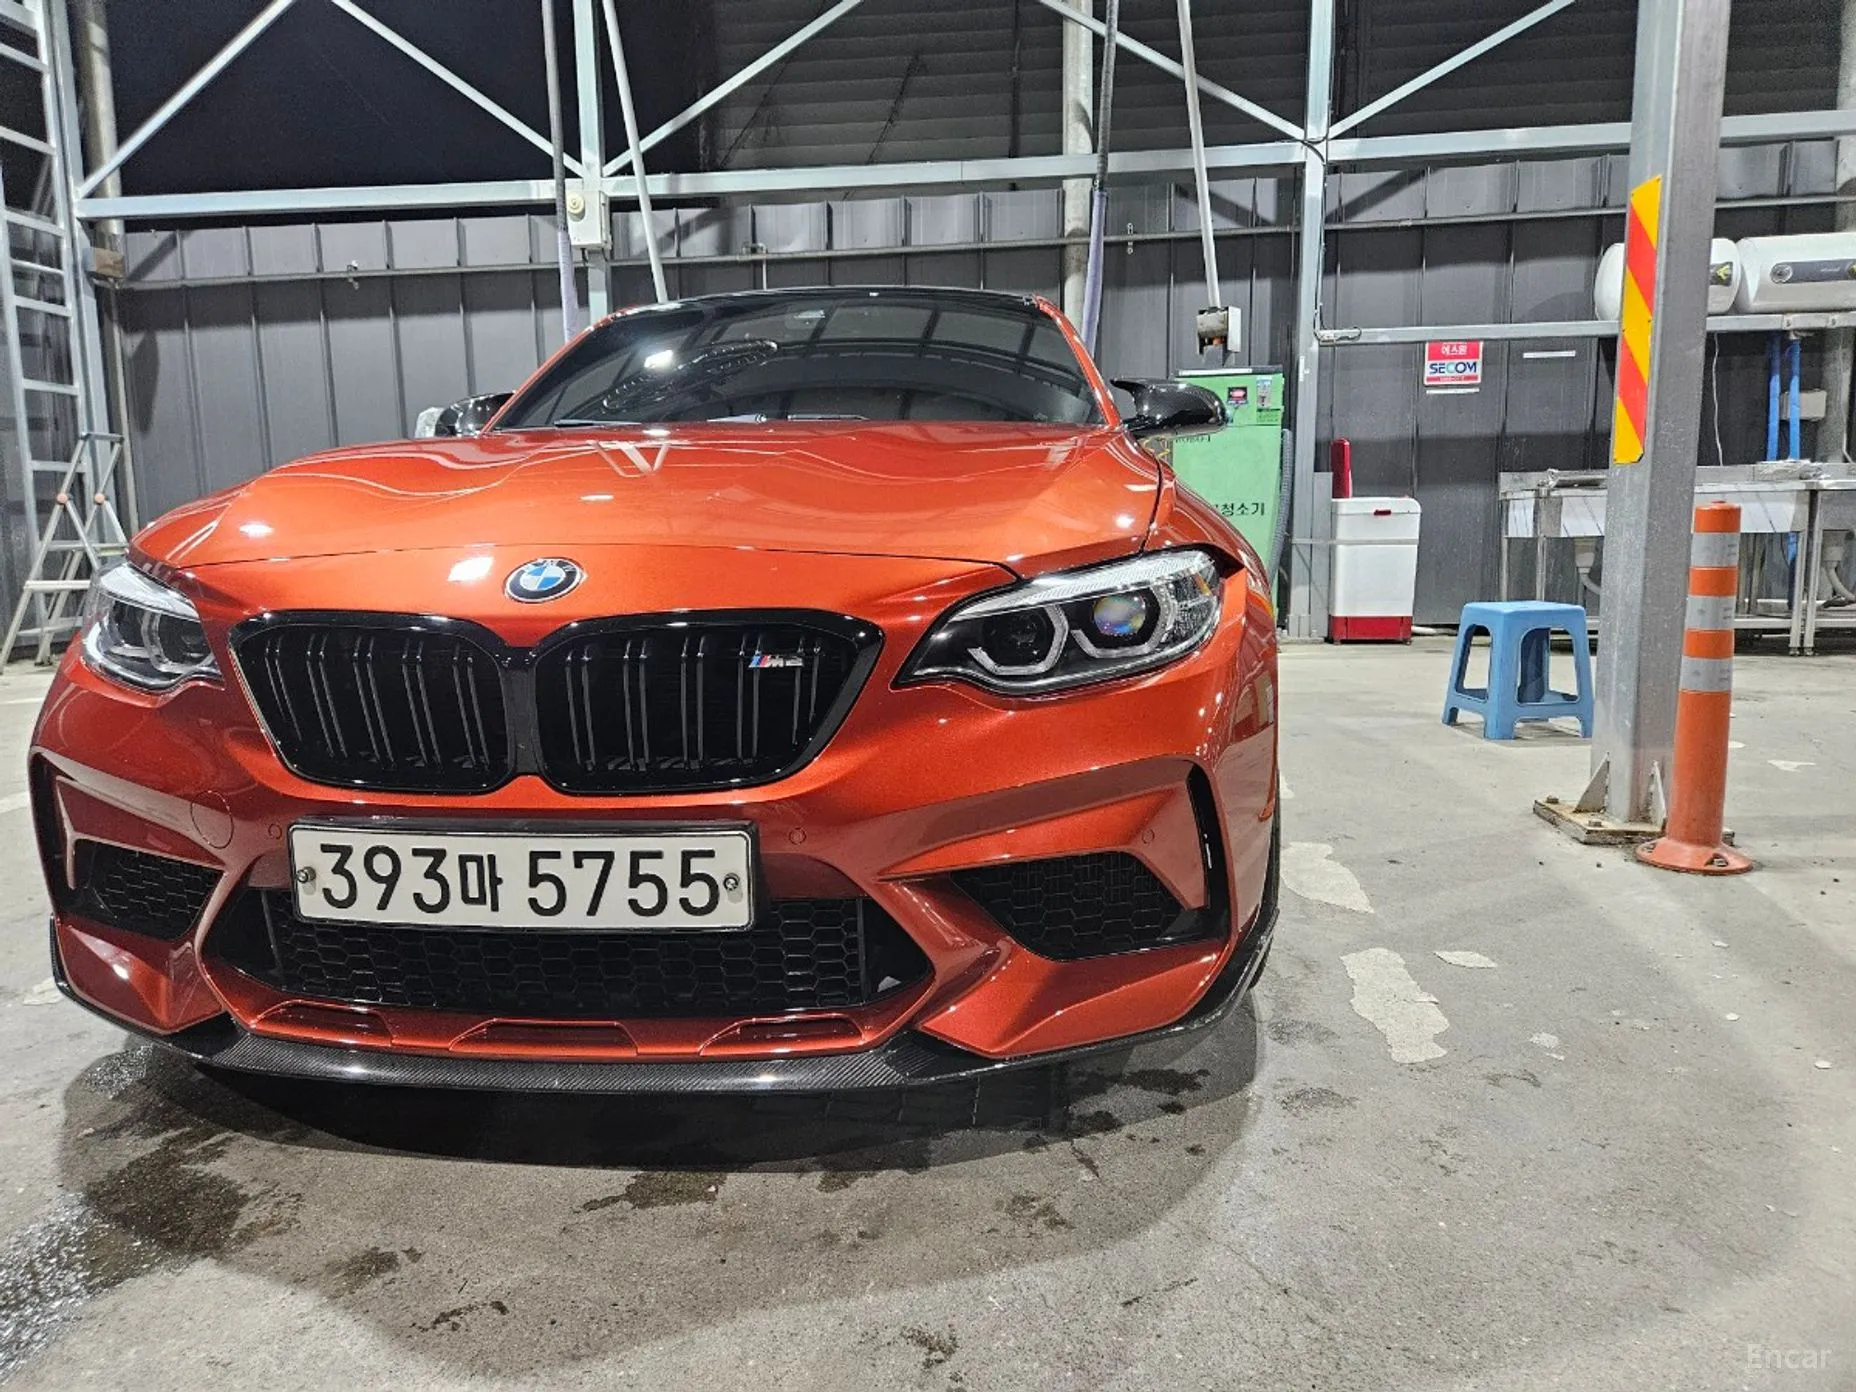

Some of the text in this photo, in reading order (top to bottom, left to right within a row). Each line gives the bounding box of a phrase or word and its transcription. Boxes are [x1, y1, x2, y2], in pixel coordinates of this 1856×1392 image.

[1429, 361, 1477, 374] SECOM
[1215, 502, 1265, 516] 청소기
[319, 843, 720, 917] 393마 5755
